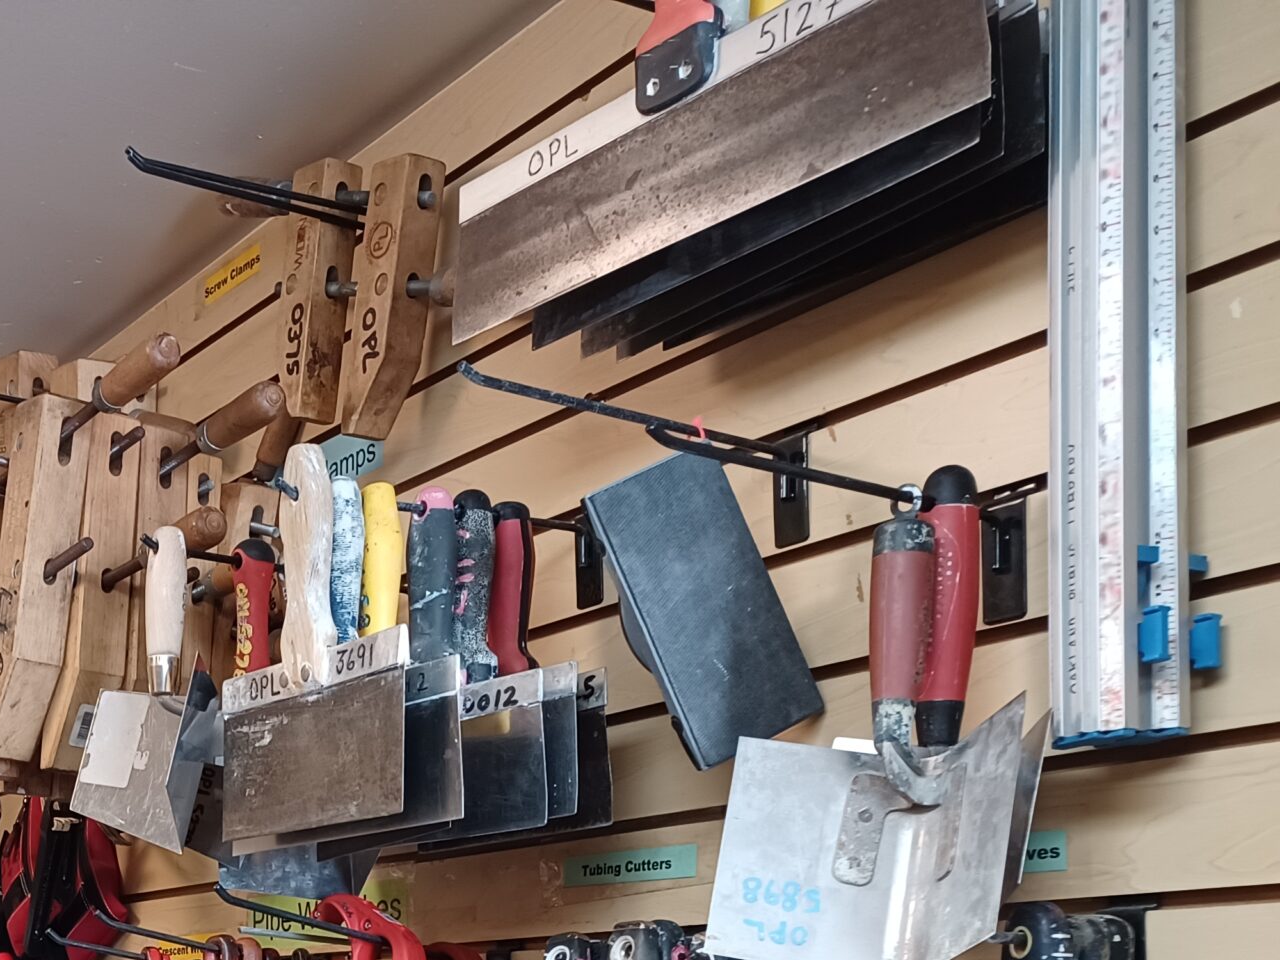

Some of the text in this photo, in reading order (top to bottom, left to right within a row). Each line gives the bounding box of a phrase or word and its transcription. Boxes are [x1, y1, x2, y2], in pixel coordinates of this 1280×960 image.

[528, 137, 579, 177] OPL
[204, 252, 261, 298] Screw Clamps
[362, 306, 380, 375] OPL
[326, 441, 377, 478] lamps
[249, 679, 279, 701] OPL
[581, 857, 672, 878] Tubing Cutters
[742, 877, 821, 914] 5898
[744, 917, 810, 947] OPL
